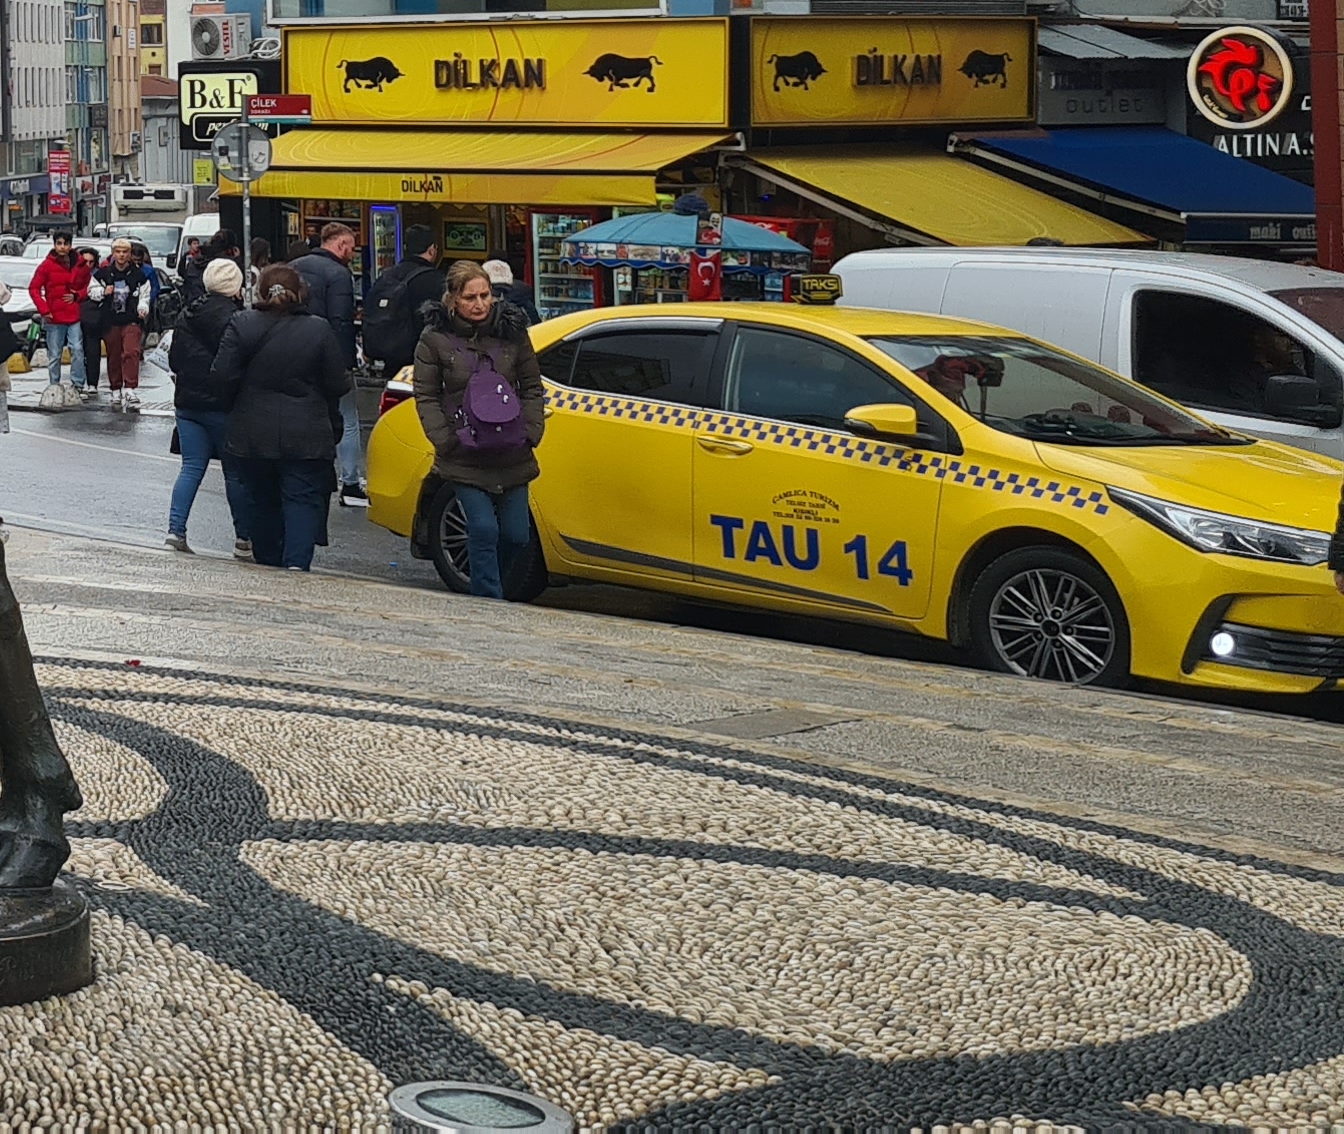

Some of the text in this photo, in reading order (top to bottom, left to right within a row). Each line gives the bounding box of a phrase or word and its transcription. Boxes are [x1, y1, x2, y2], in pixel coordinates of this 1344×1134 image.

[434, 53, 547, 92] DİLKAN
[852, 48, 942, 88] DİLKAN
[250, 98, 277, 109] ÇİLEK
[401, 176, 444, 193] DİLKAN
[710, 514, 914, 587] TAU 14
